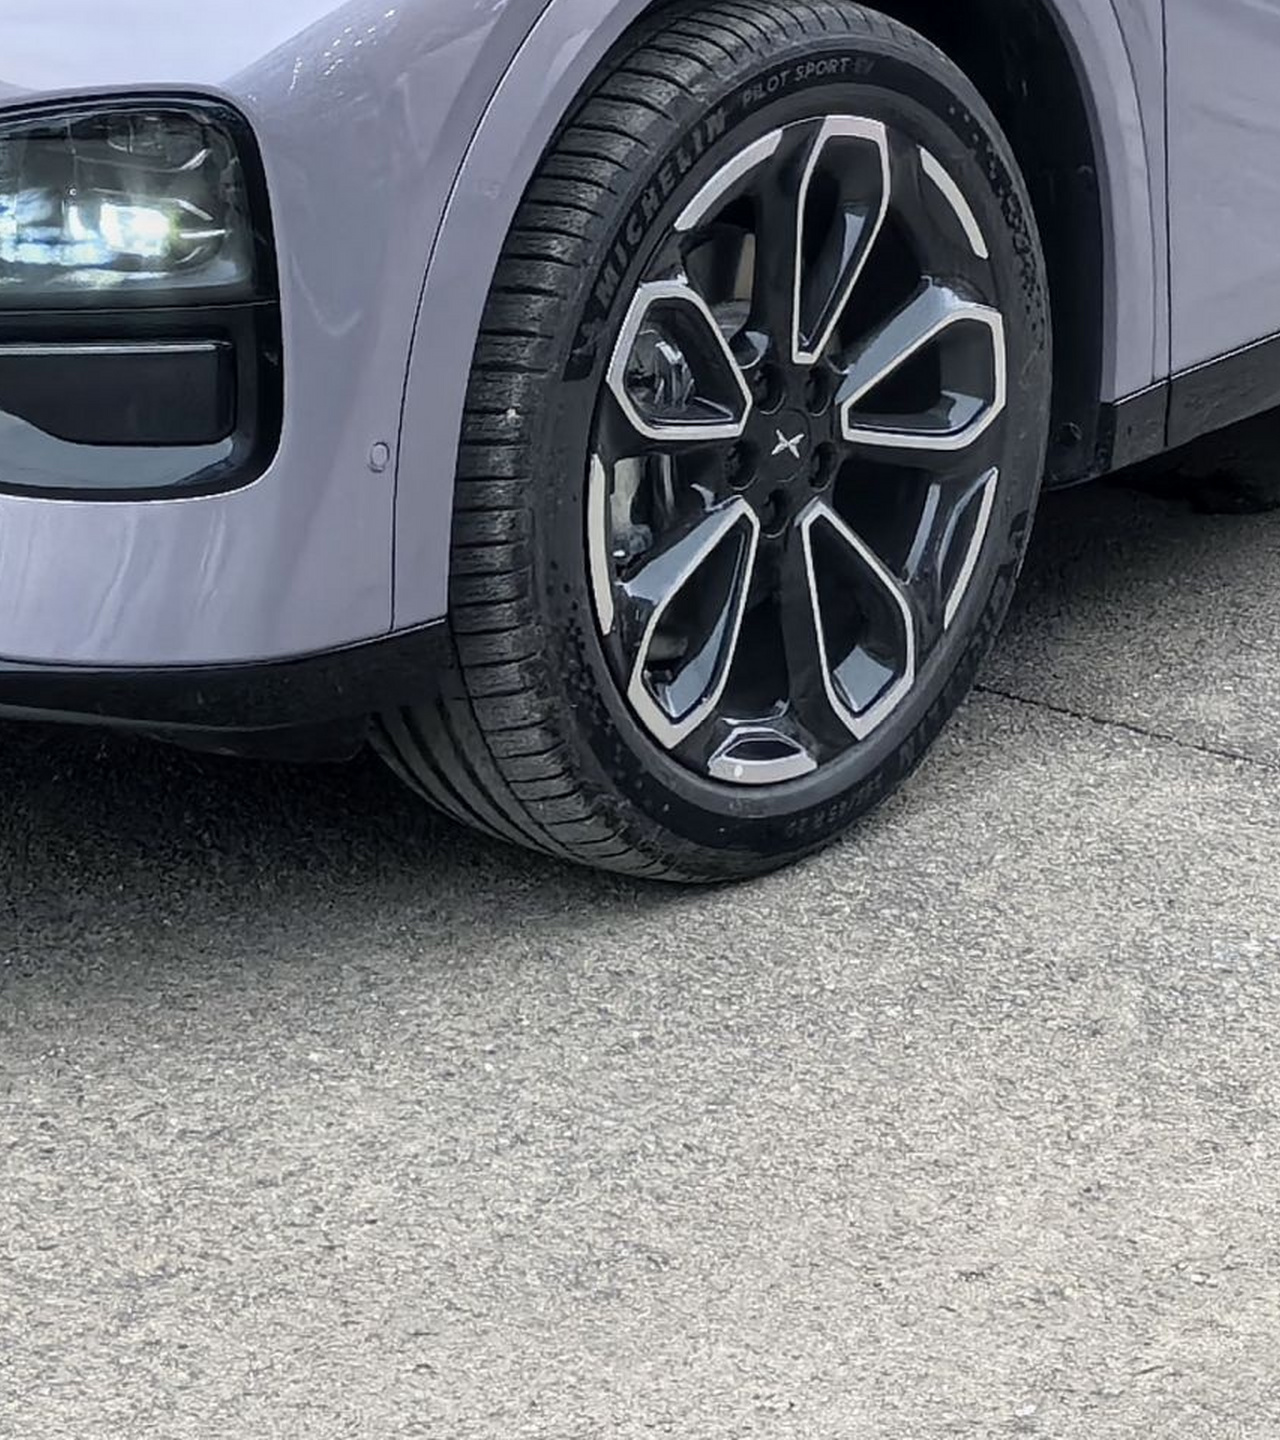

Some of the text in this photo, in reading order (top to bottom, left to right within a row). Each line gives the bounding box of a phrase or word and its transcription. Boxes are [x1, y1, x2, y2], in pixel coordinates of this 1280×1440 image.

[592, 107, 727, 309] MICHELIN
[741, 69, 791, 107] PILOT
[794, 57, 851, 82] SPORT
